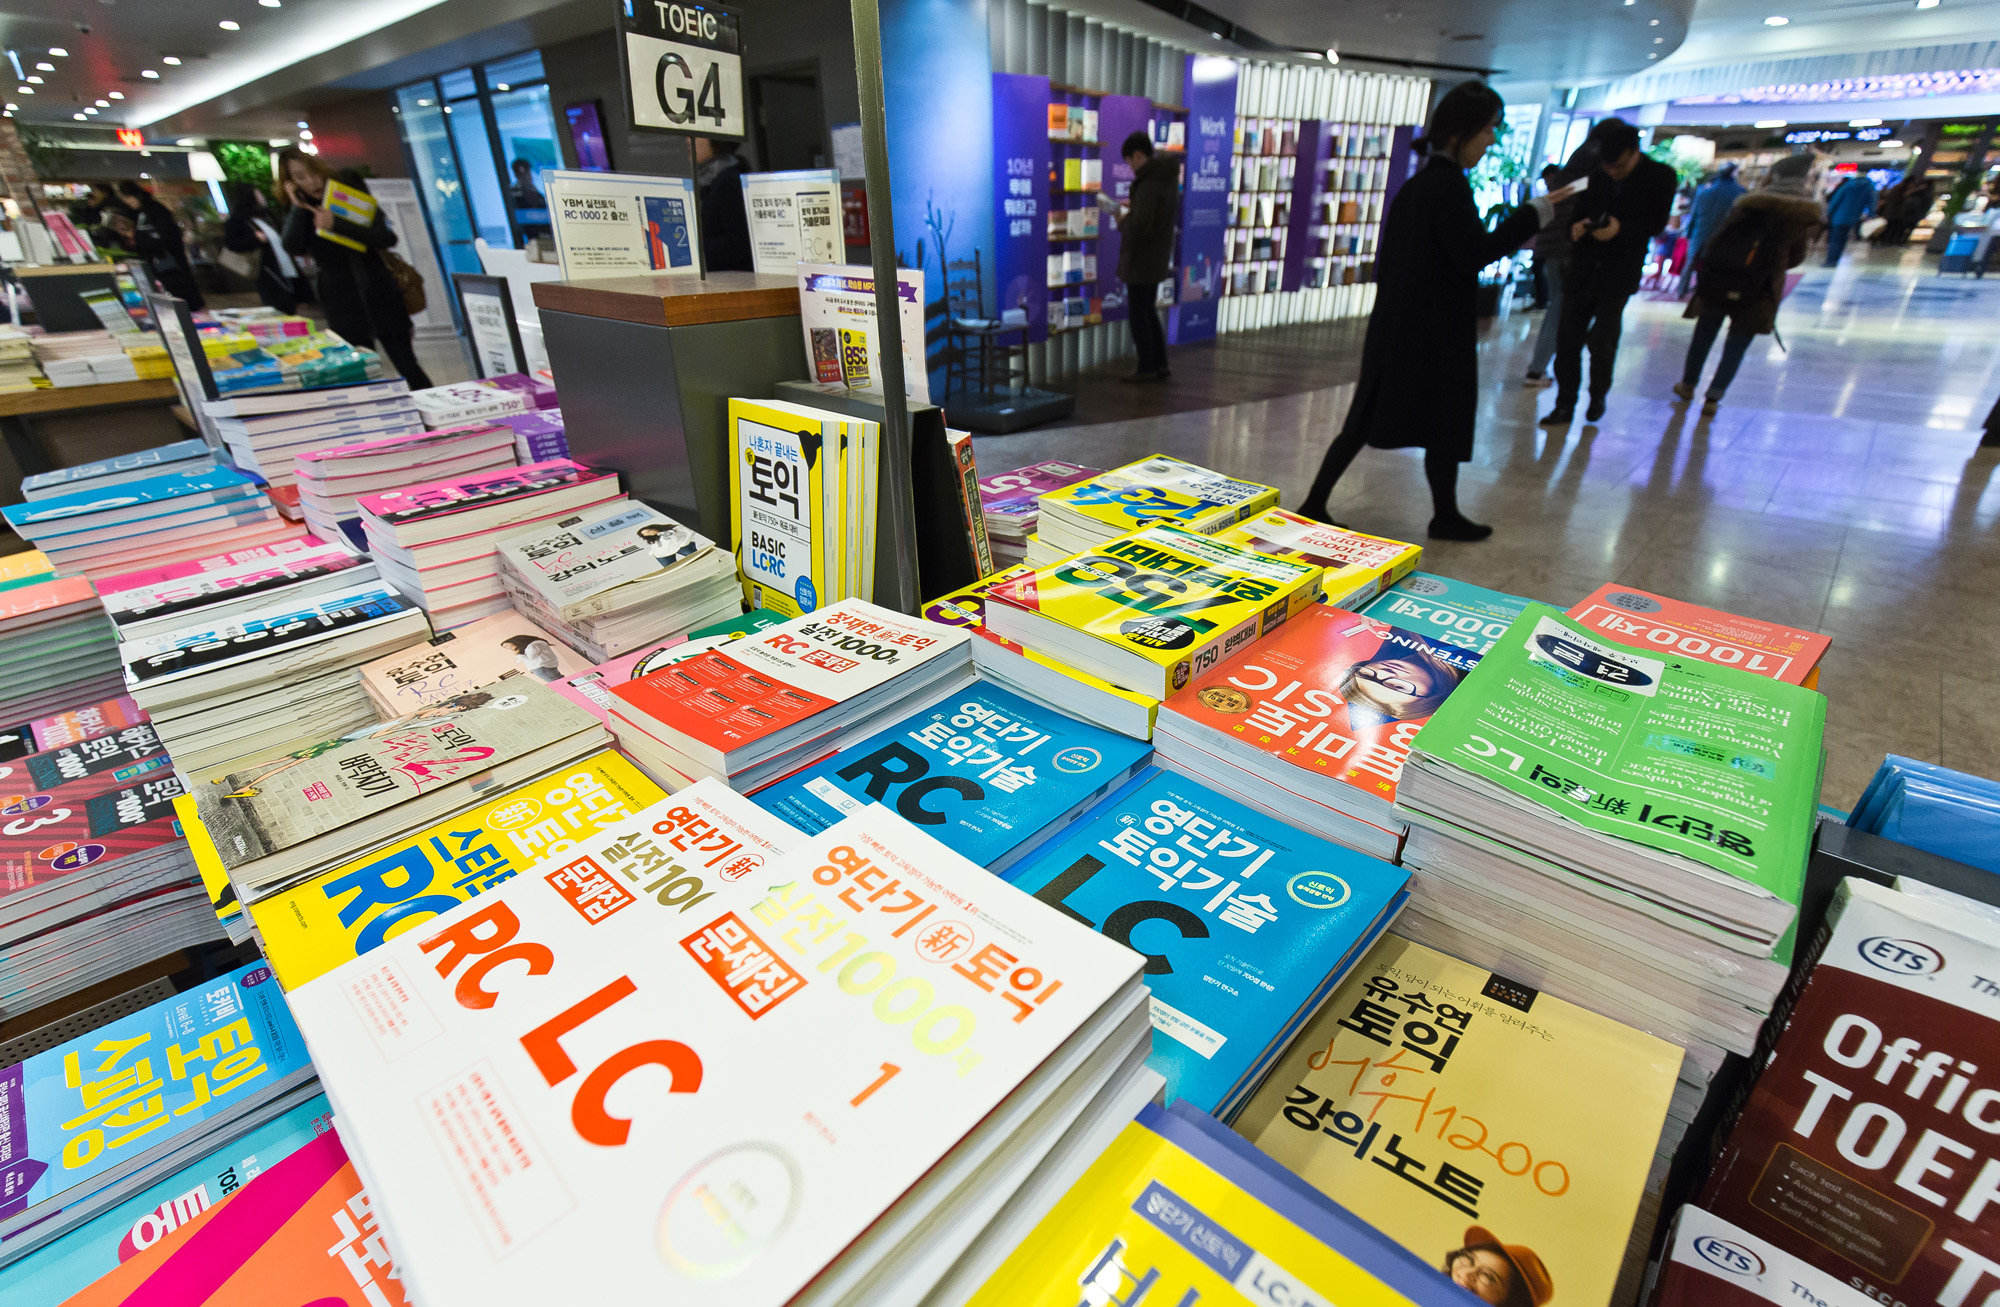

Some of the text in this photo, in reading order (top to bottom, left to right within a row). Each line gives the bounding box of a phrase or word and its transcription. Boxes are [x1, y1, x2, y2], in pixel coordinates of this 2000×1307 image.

[654, 1, 717, 40] TOEIC
[655, 52, 726, 127] G4
[562, 198, 616, 209] YBM 실전토익
[564, 210, 578, 219] RC
[580, 211, 600, 220] 1000
[602, 212, 608, 220] 2
[777, 209, 785, 218] RC
[674, 226, 688, 247] 2
[804, 237, 823, 256] RC
[845, 346, 868, 365] 850
[748, 435, 798, 463] 나혼자 끝내는
[749, 454, 800, 521] 토익
[519, 532, 574, 553] 유수연
[527, 538, 584, 561] 토익
[751, 530, 786, 559] BASIC
[1311, 531, 1398, 556] READING
[533, 551, 573, 570] LC
[547, 545, 645, 583] 강의노트
[1103, 540, 1280, 602] 완벽대비
[1331, 552, 1381, 569] NEW
[1052, 555, 1245, 634] 750
[763, 634, 811, 656] RC
[799, 622, 902, 666] 실전 1000제
[826, 611, 884, 637] 정재현
[890, 634, 939, 652] 토익
[1597, 613, 1769, 671] 1000제
[385, 651, 448, 680] 유수연
[393, 656, 458, 690] 토익
[803, 650, 858, 673] 문제집
[1194, 646, 1219, 674] 750
[397, 674, 460, 700] RC
[1504, 683, 1552, 709] Similar
[1509, 677, 1623, 729] to the Actual Test
[1659, 689, 1722, 710] Points
[1662, 681, 1718, 701] Notes
[1489, 701, 1529, 727] Codes
[1553, 706, 1621, 736] Sentences
[1721, 697, 1768, 713] Side
[1727, 702, 1789, 728] Focus
[1771, 707, 1792, 718] in
[118, 725, 164, 760] 해커스
[951, 702, 1052, 756] 영단기
[1484, 707, 1559, 747] Lectures
[1530, 720, 1554, 736] QR
[1644, 718, 1781, 759] Various Types of
[1649, 710, 1784, 750] Free Audio Files
[80, 735, 122, 764] 토익
[908, 721, 1039, 795] 토익기술
[1555, 731, 1608, 758] through
[1560, 741, 1604, 766] Free
[338, 753, 400, 799] 벼락치기
[835, 741, 985, 825] RC
[1625, 760, 1670, 777] TOEIC
[143, 776, 186, 807] 토익
[1463, 735, 1756, 857] 영단기 LC
[1621, 769, 1768, 816] Complete Analyses
[3, 808, 72, 835] 3
[651, 806, 742, 869] 영단기
[1144, 799, 1275, 879] 영단기
[601, 831, 664, 884] 실전
[551, 860, 630, 919] 문제집
[1098, 826, 1279, 934] 토익기술
[1308, 881, 1335, 895] 신토익
[1032, 853, 1210, 976] LC
[812, 845, 1063, 1025] 영단기 新 토익
[418, 899, 555, 1010] RC
[694, 923, 796, 1014] 문제집
[1872, 943, 1929, 971] ETS
[256, 968, 266, 982] 2018
[750, 879, 985, 1079] 실전 1000제
[1202, 974, 1240, 997] 영단기 연구소
[1242, 972, 1260, 985] 700점
[175, 1001, 192, 1023] Level
[206, 985, 239, 1023] 토커비
[1361, 975, 1474, 1036] 유수연
[1404, 975, 1432, 995] 답이
[1428, 985, 1459, 1003] 되는
[1456, 993, 1498, 1018] 어휘를
[1497, 1011, 1557, 1043] 알려주는
[1337, 998, 1464, 1075] 토익
[166, 1016, 268, 1117] 토익
[519, 975, 703, 1147] LC
[60, 1032, 171, 1170] 스피킹
[850, 1062, 902, 1108] 1
[1282, 1083, 1486, 1221] 강의노트
[1789, 1160, 1818, 1182] Each
[1820, 1174, 1842, 1193] test
[1785, 1190, 1819, 1213] Audio
[1791, 1178, 1862, 1221] Answer keys
[1146, 1190, 1243, 1271] 영단기 신토익
[1704, 1239, 1753, 1272] ETS
[1846, 1240, 1887, 1267] guides
[1789, 1279, 1829, 1307] The
